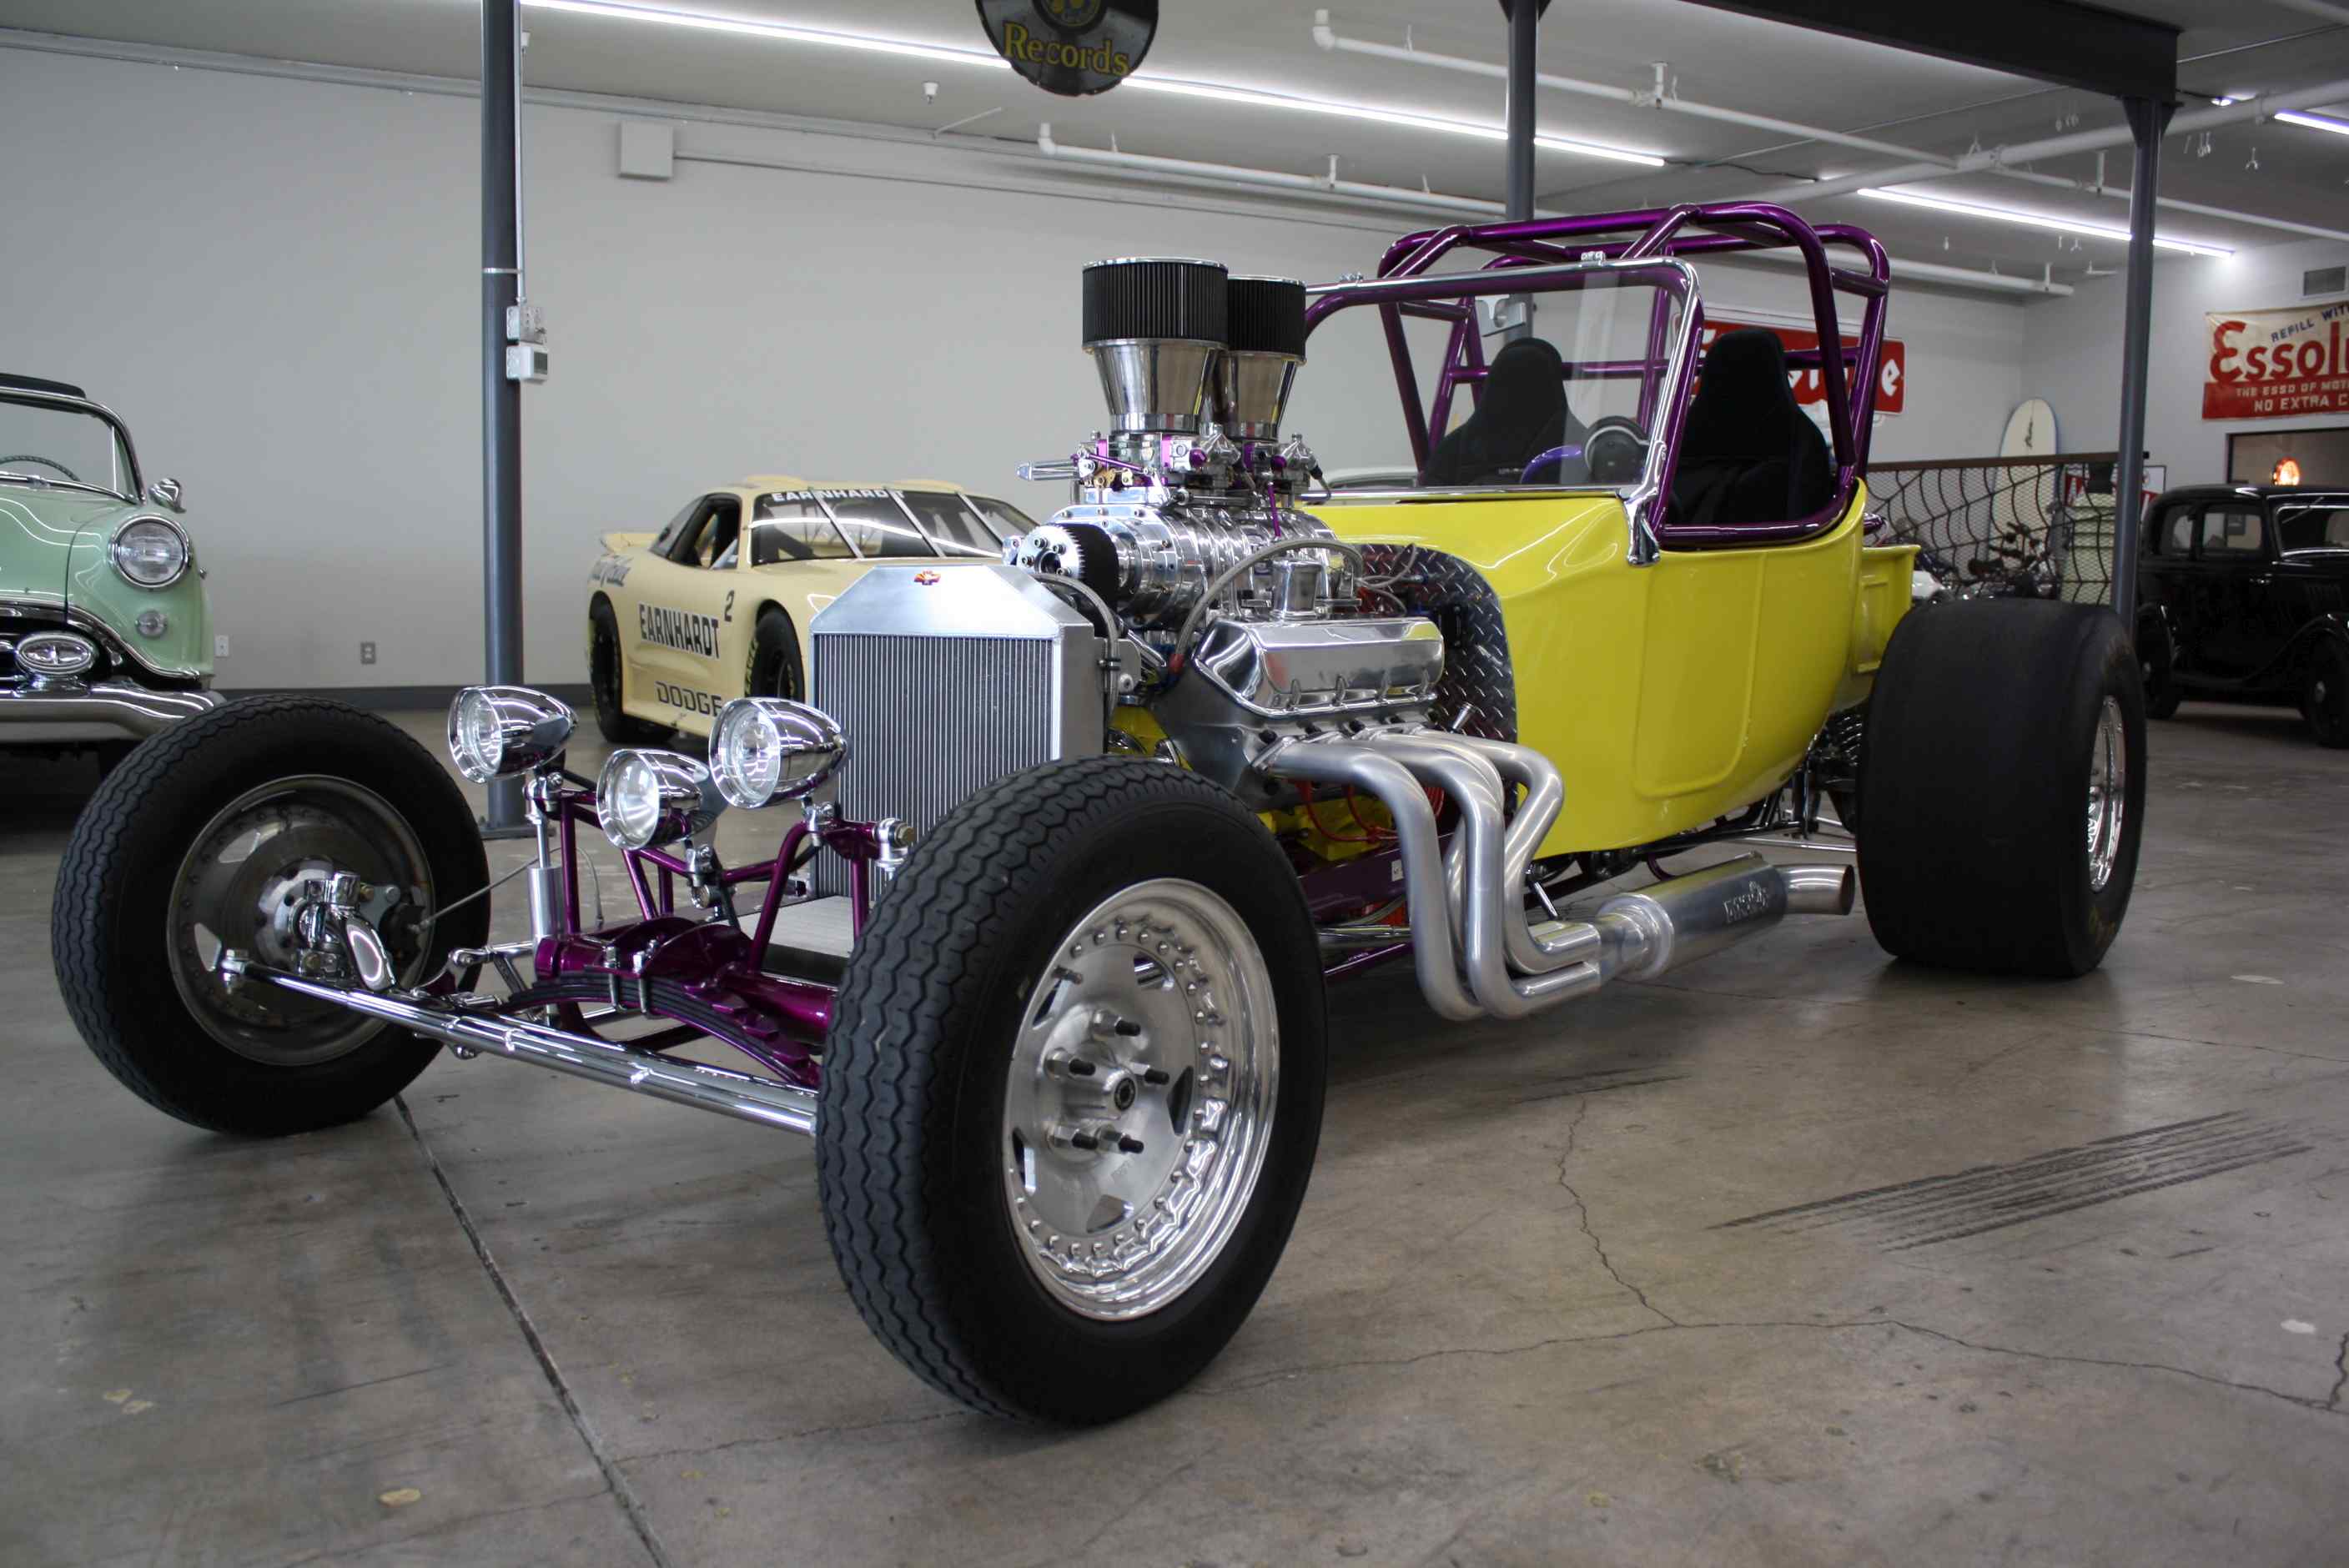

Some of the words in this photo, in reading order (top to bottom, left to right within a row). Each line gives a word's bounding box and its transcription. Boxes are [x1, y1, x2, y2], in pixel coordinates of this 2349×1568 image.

[1002, 20, 1130, 77] Records
[2271, 319, 2315, 342] REFILL
[2322, 302, 2349, 321] WIT
[2236, 387, 2257, 398] THE
[2301, 382, 2317, 393] OF
[2321, 379, 2349, 391] MOT
[2254, 399, 2274, 413] NO
[2280, 395, 2330, 410] EXTRA
[724, 589, 735, 622] 2
[639, 603, 720, 659] EARNHARDT
[655, 681, 722, 717] DODGE
